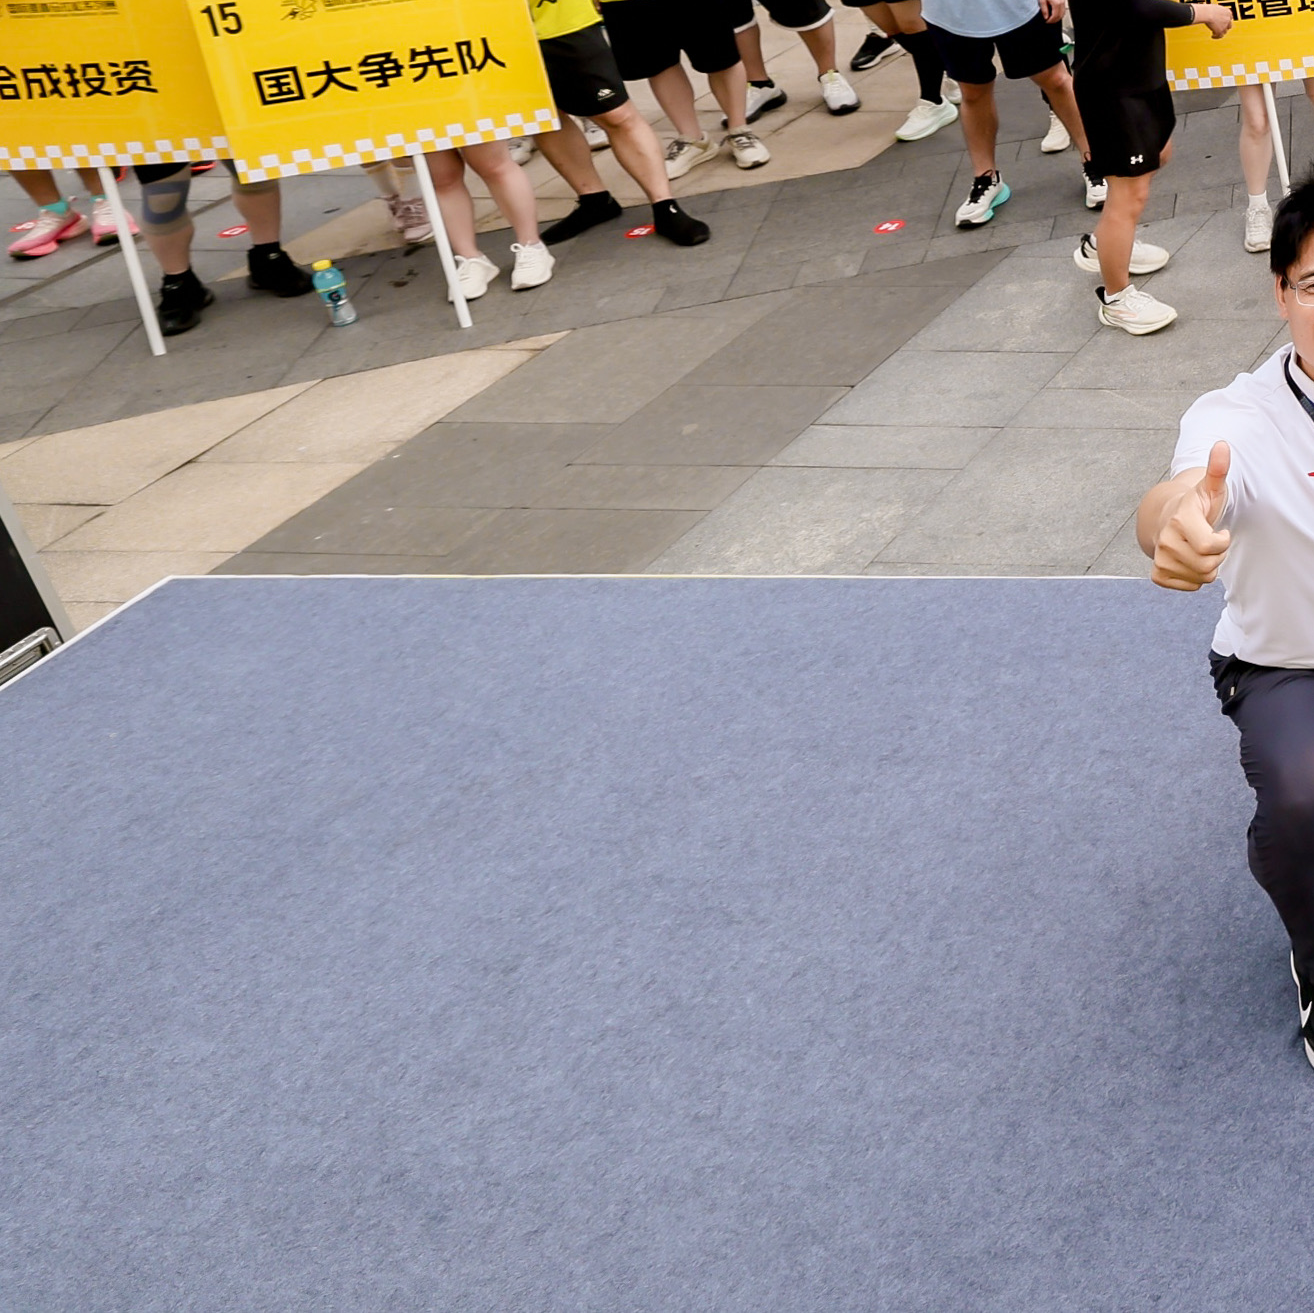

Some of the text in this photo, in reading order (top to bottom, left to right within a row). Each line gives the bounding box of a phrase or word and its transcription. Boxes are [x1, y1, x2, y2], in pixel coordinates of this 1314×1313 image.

[200, 3, 243, 38] 15
[253, 37, 507, 107] 国大争先队
